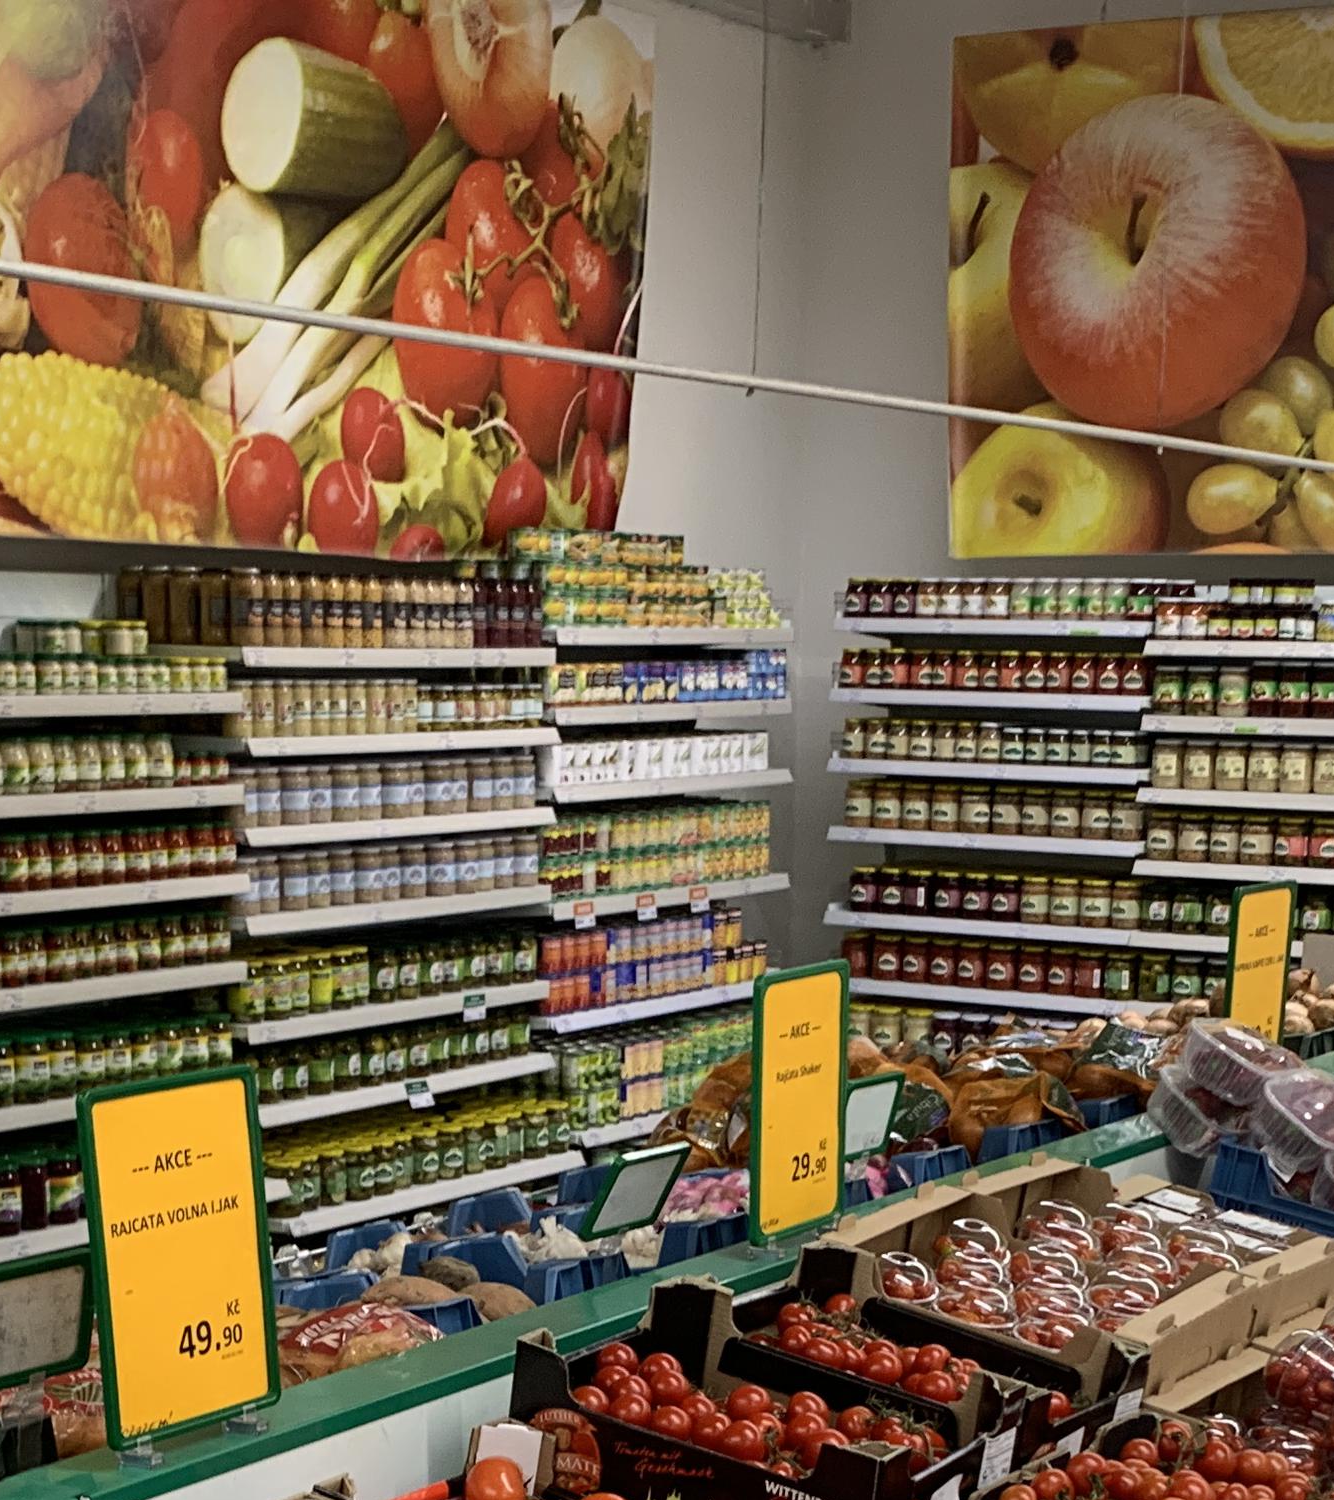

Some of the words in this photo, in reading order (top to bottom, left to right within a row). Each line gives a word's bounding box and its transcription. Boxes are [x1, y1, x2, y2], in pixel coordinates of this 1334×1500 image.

[789, 1022, 811, 1040] AKCE
[153, 1148, 193, 1174] AKCE
[110, 1211, 166, 1239] RAJCATA
[166, 1201, 209, 1226] VOLNA
[226, 1298, 241, 1317] Kč
